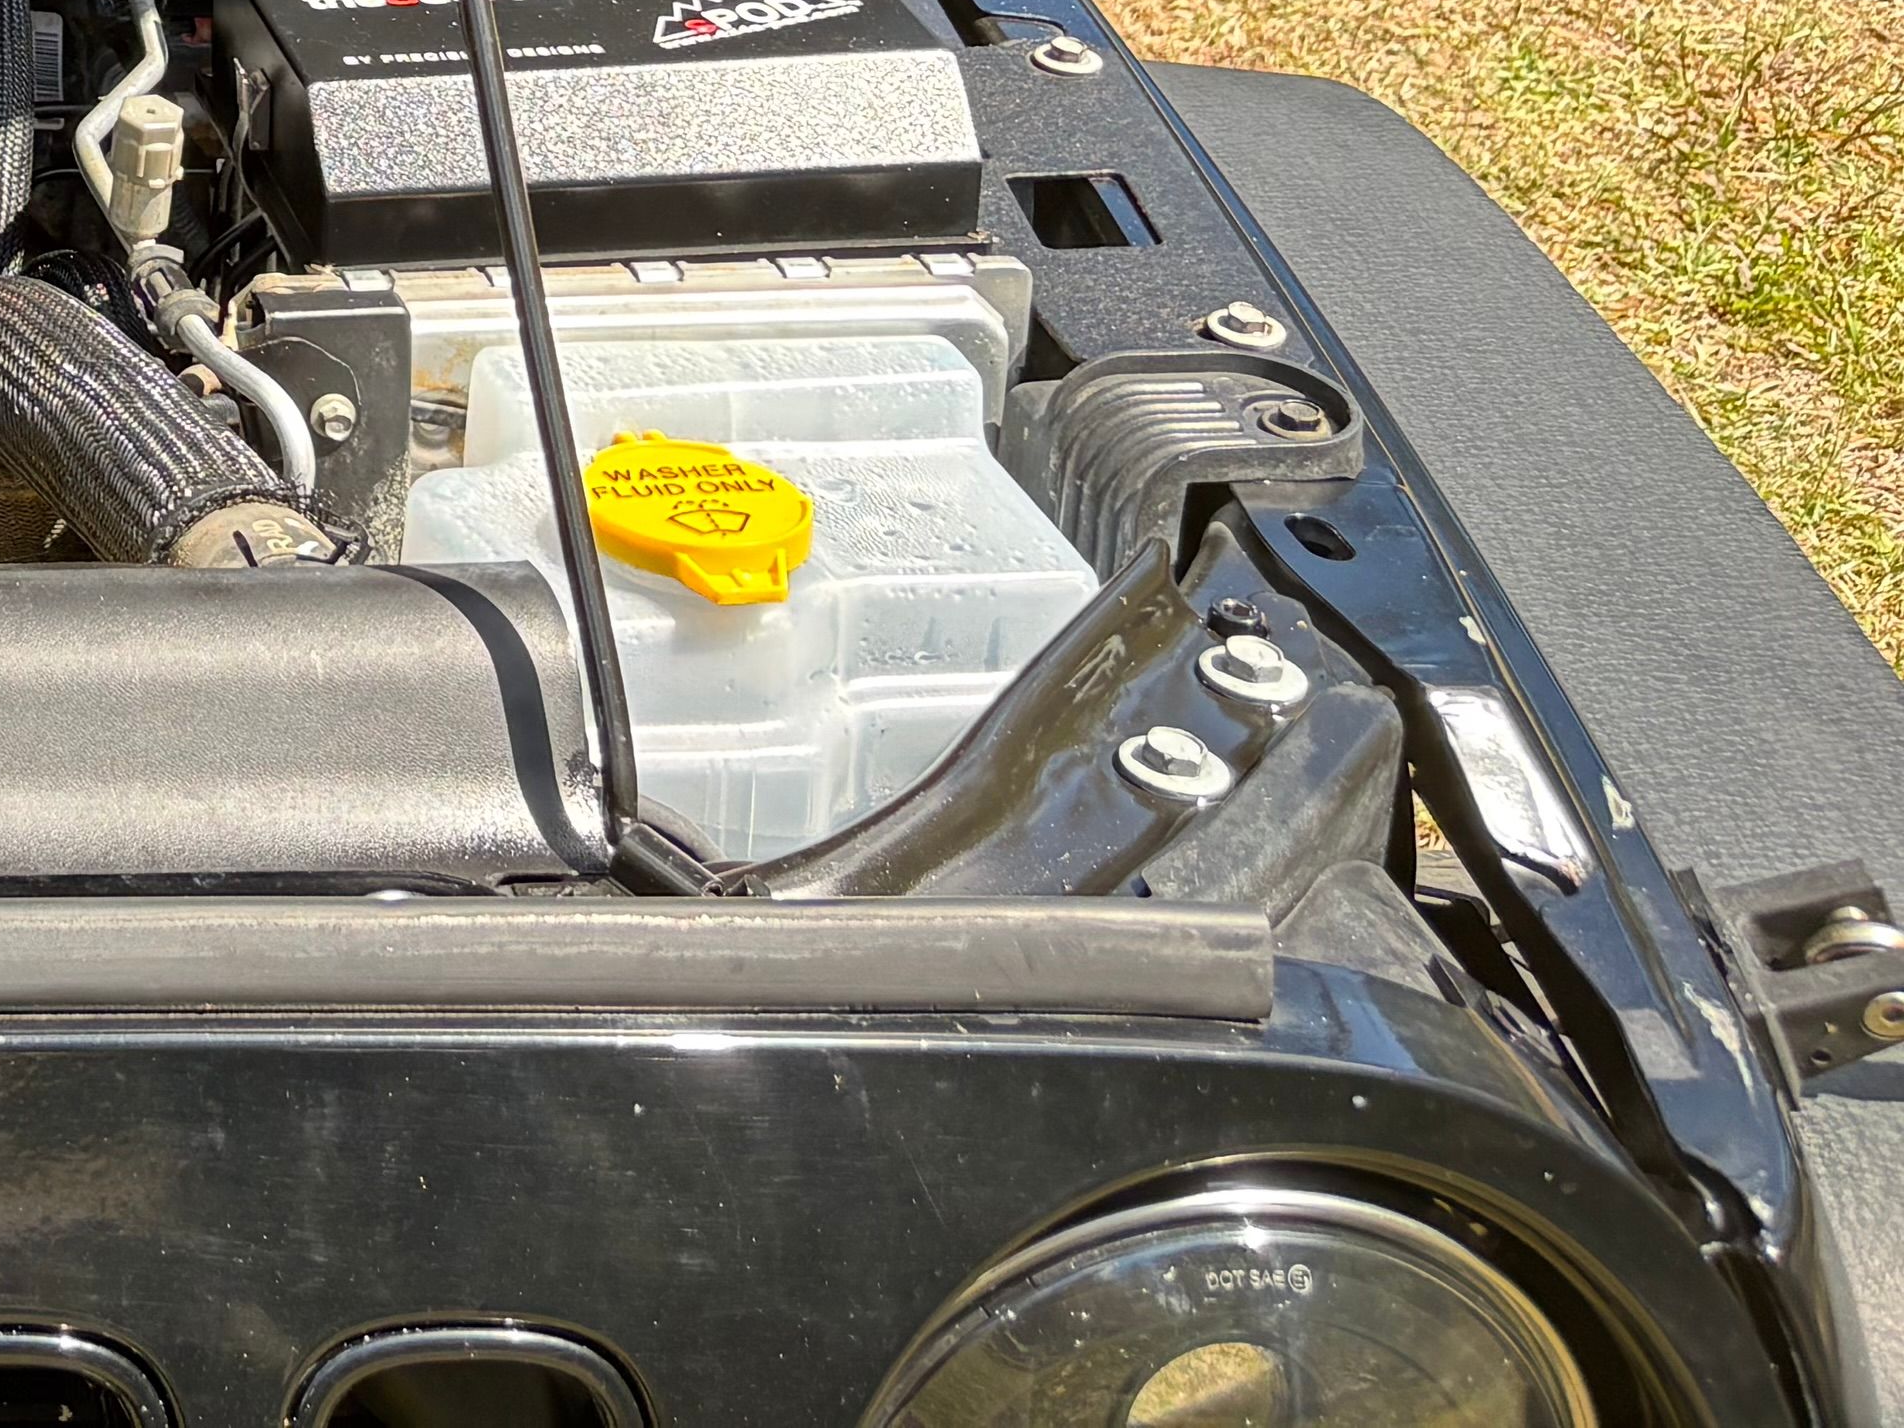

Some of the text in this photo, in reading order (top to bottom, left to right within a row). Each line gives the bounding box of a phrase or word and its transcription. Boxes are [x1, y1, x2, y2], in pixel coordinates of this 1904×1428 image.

[342, 43, 607, 67] BY PRECISI DESIGNS
[602, 463, 747, 482] WASHER
[591, 478, 776, 499] FLUID ONLY
[1205, 1269, 1245, 1290] DOT
[1249, 1268, 1286, 1290] SAE
